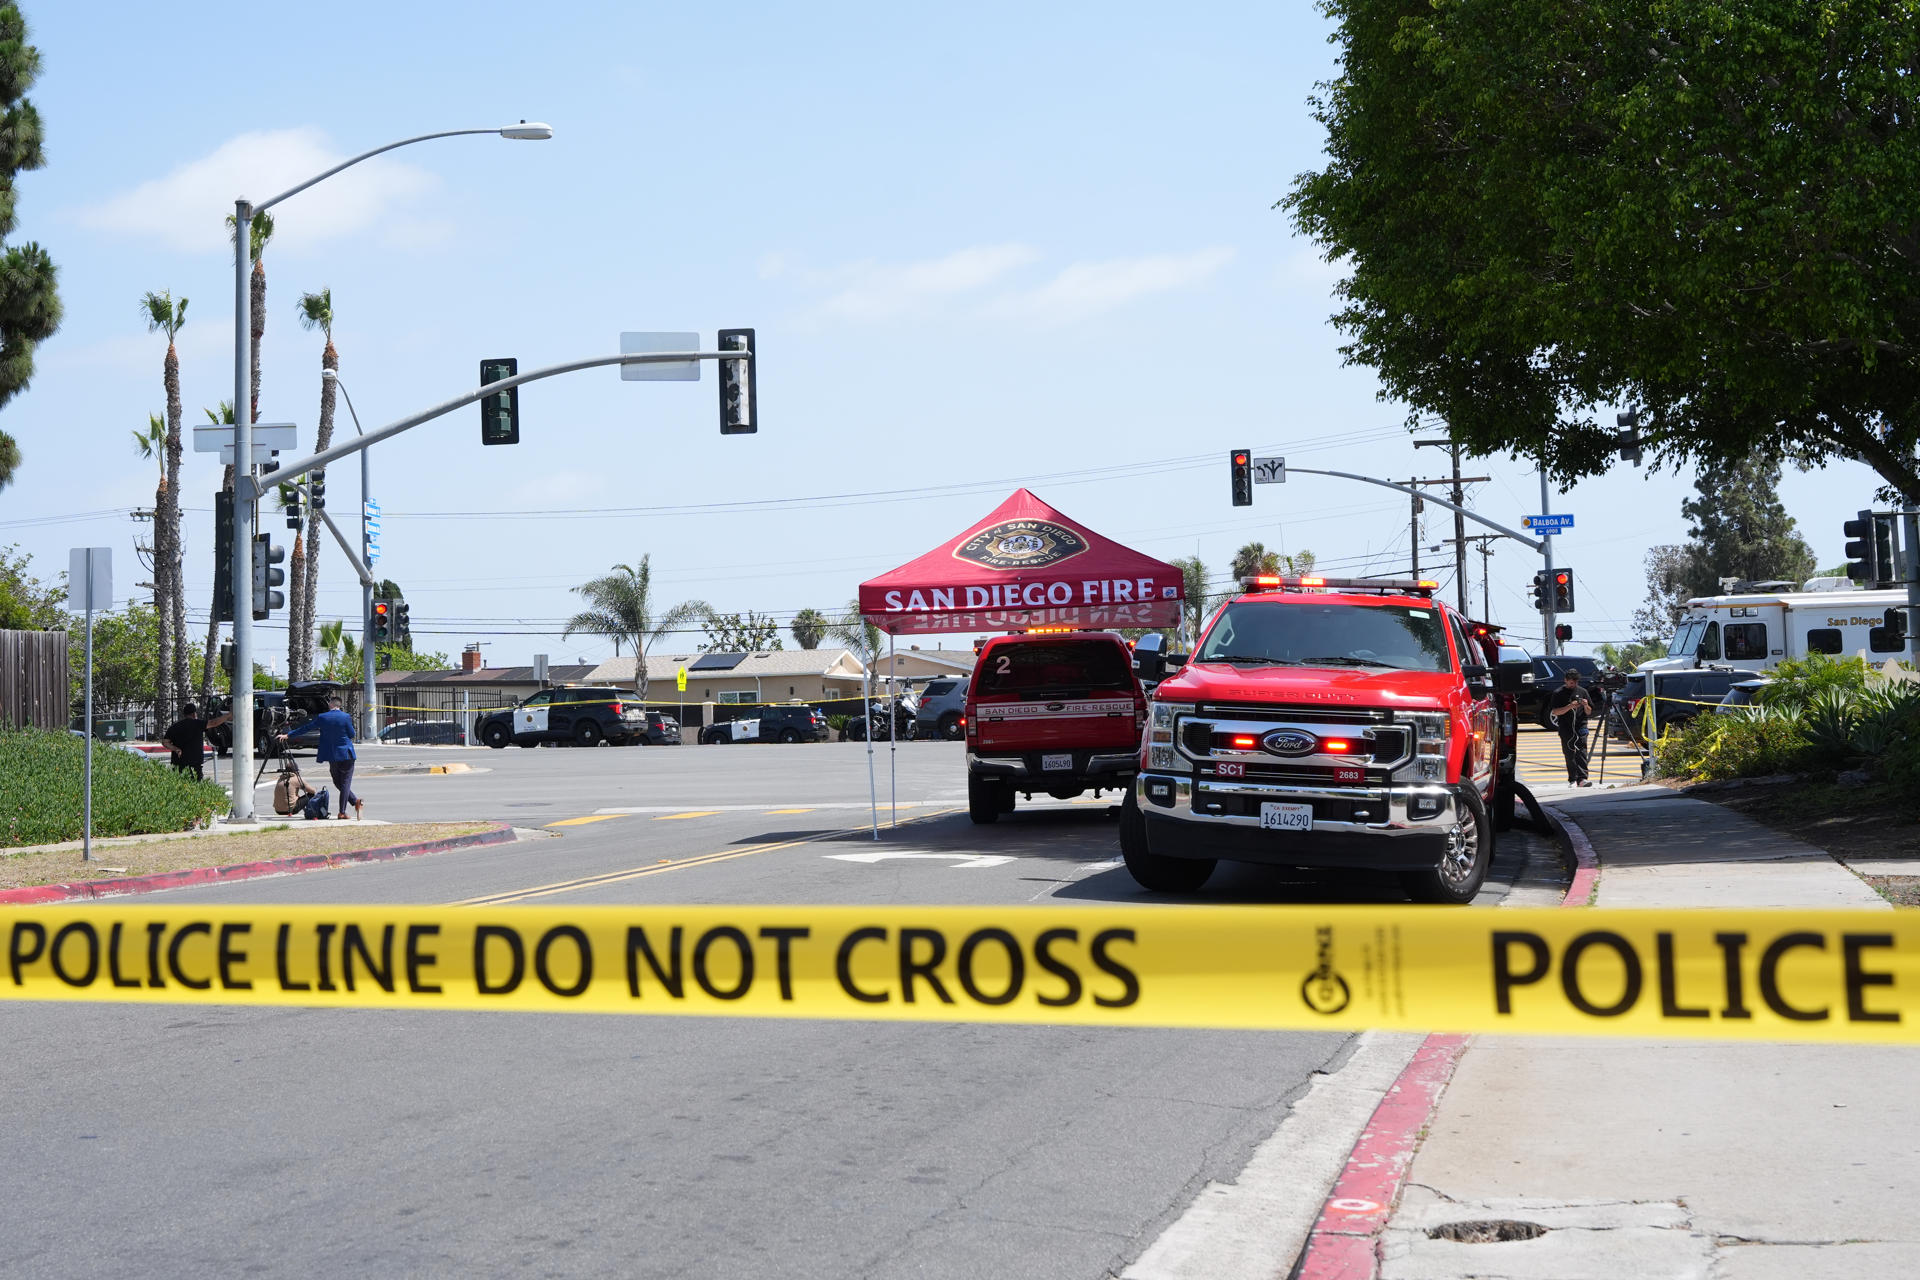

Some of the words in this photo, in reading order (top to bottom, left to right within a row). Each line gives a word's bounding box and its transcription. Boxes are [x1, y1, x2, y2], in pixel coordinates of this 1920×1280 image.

[1532, 518, 1559, 526] BALBOA
[966, 533, 991, 551] CITY
[1007, 522, 1038, 530] SAN
[1041, 525, 1077, 546] DIEGO
[980, 552, 1062, 566] FIRE-RESCUE
[884, 587, 955, 612] SAN
[965, 582, 1072, 609] DIEGO
[1083, 578, 1156, 603] FIRE
[1827, 617, 1848, 626] San
[1850, 616, 1883, 627] Diego
[996, 656, 1011, 674] 2
[1228, 689, 1300, 698] SUPER
[1305, 692, 1360, 701] DUTY
[1008, 706, 1038, 714] DIEGO
[1066, 703, 1132, 712] FIRE-RESCUE
[1275, 736, 1302, 749] Ford
[1218, 763, 1243, 776] SC1
[1339, 771, 1359, 780] 2683
[1263, 812, 1309, 827] 1614290
[9, 921, 254, 988] POLICE
[277, 923, 444, 994] LINE
[473, 924, 594, 998] DO
[625, 925, 811, 1001] NOT
[835, 927, 1141, 1008] CROSS
[1490, 928, 1902, 1023] POLICE
